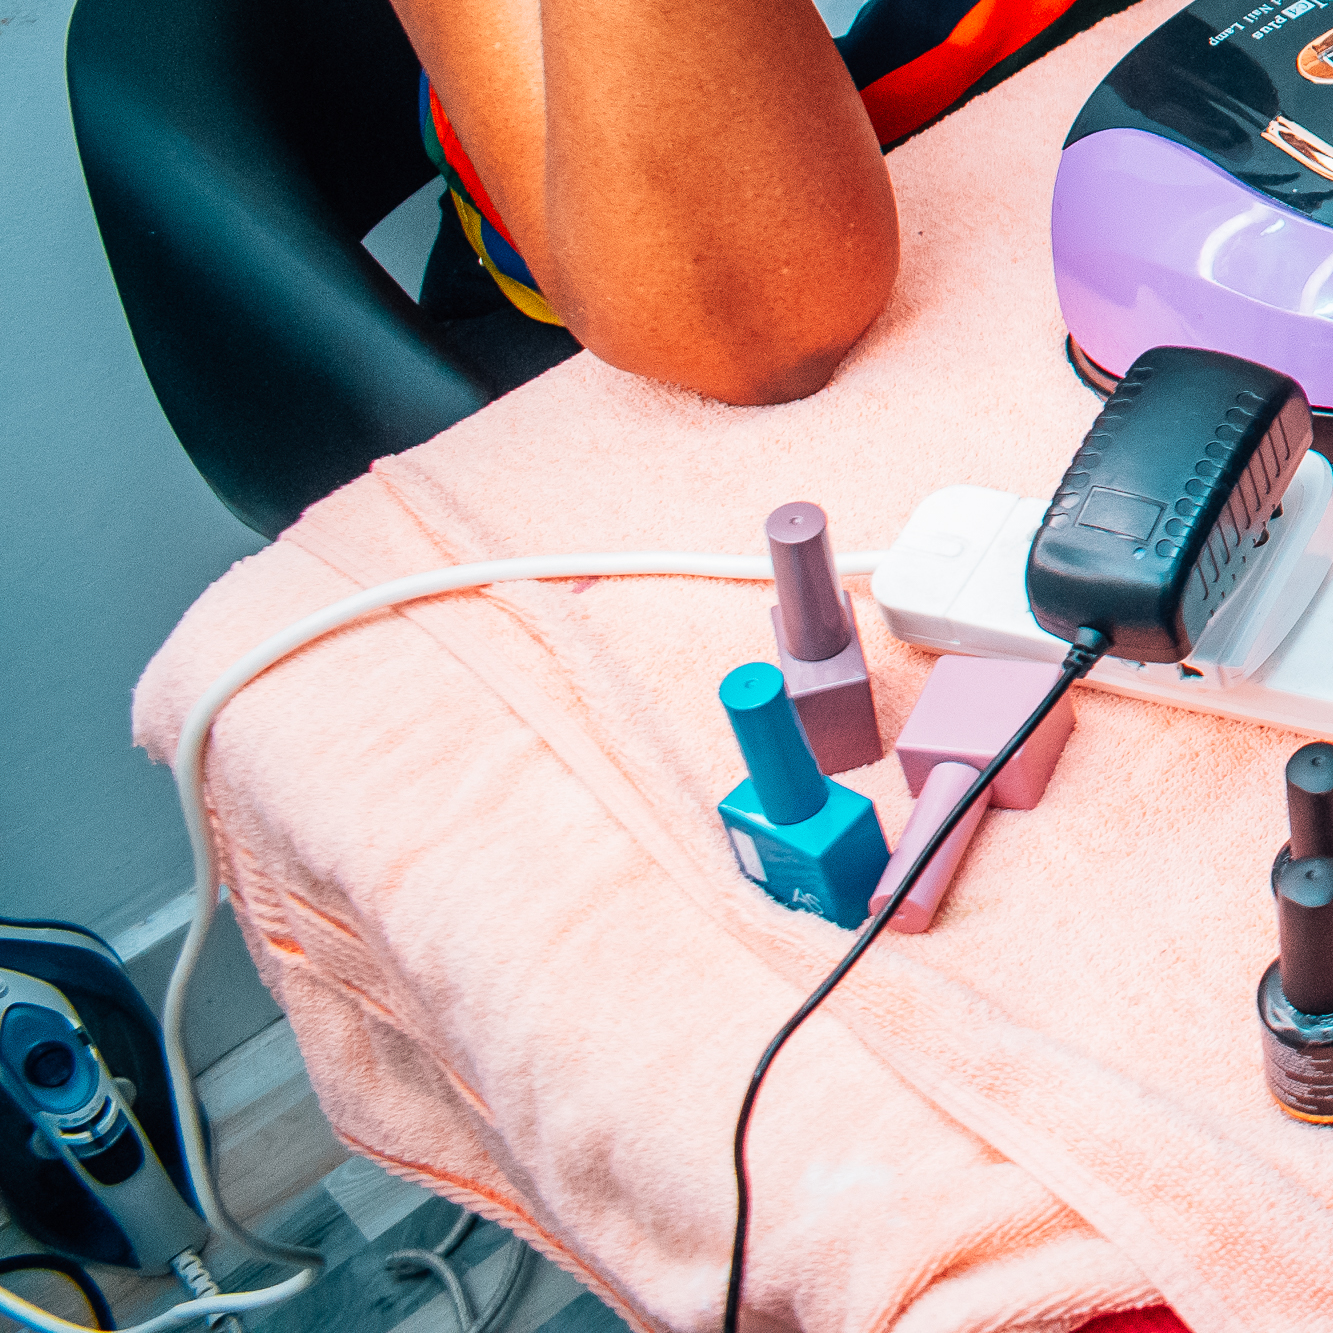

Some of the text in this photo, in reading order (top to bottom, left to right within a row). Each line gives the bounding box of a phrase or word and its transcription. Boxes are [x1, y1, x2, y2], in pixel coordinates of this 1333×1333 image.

[1243, 3, 1275, 23] Nail
[1208, 22, 1245, 46] Lamp
[1252, 14, 1287, 40] plus
